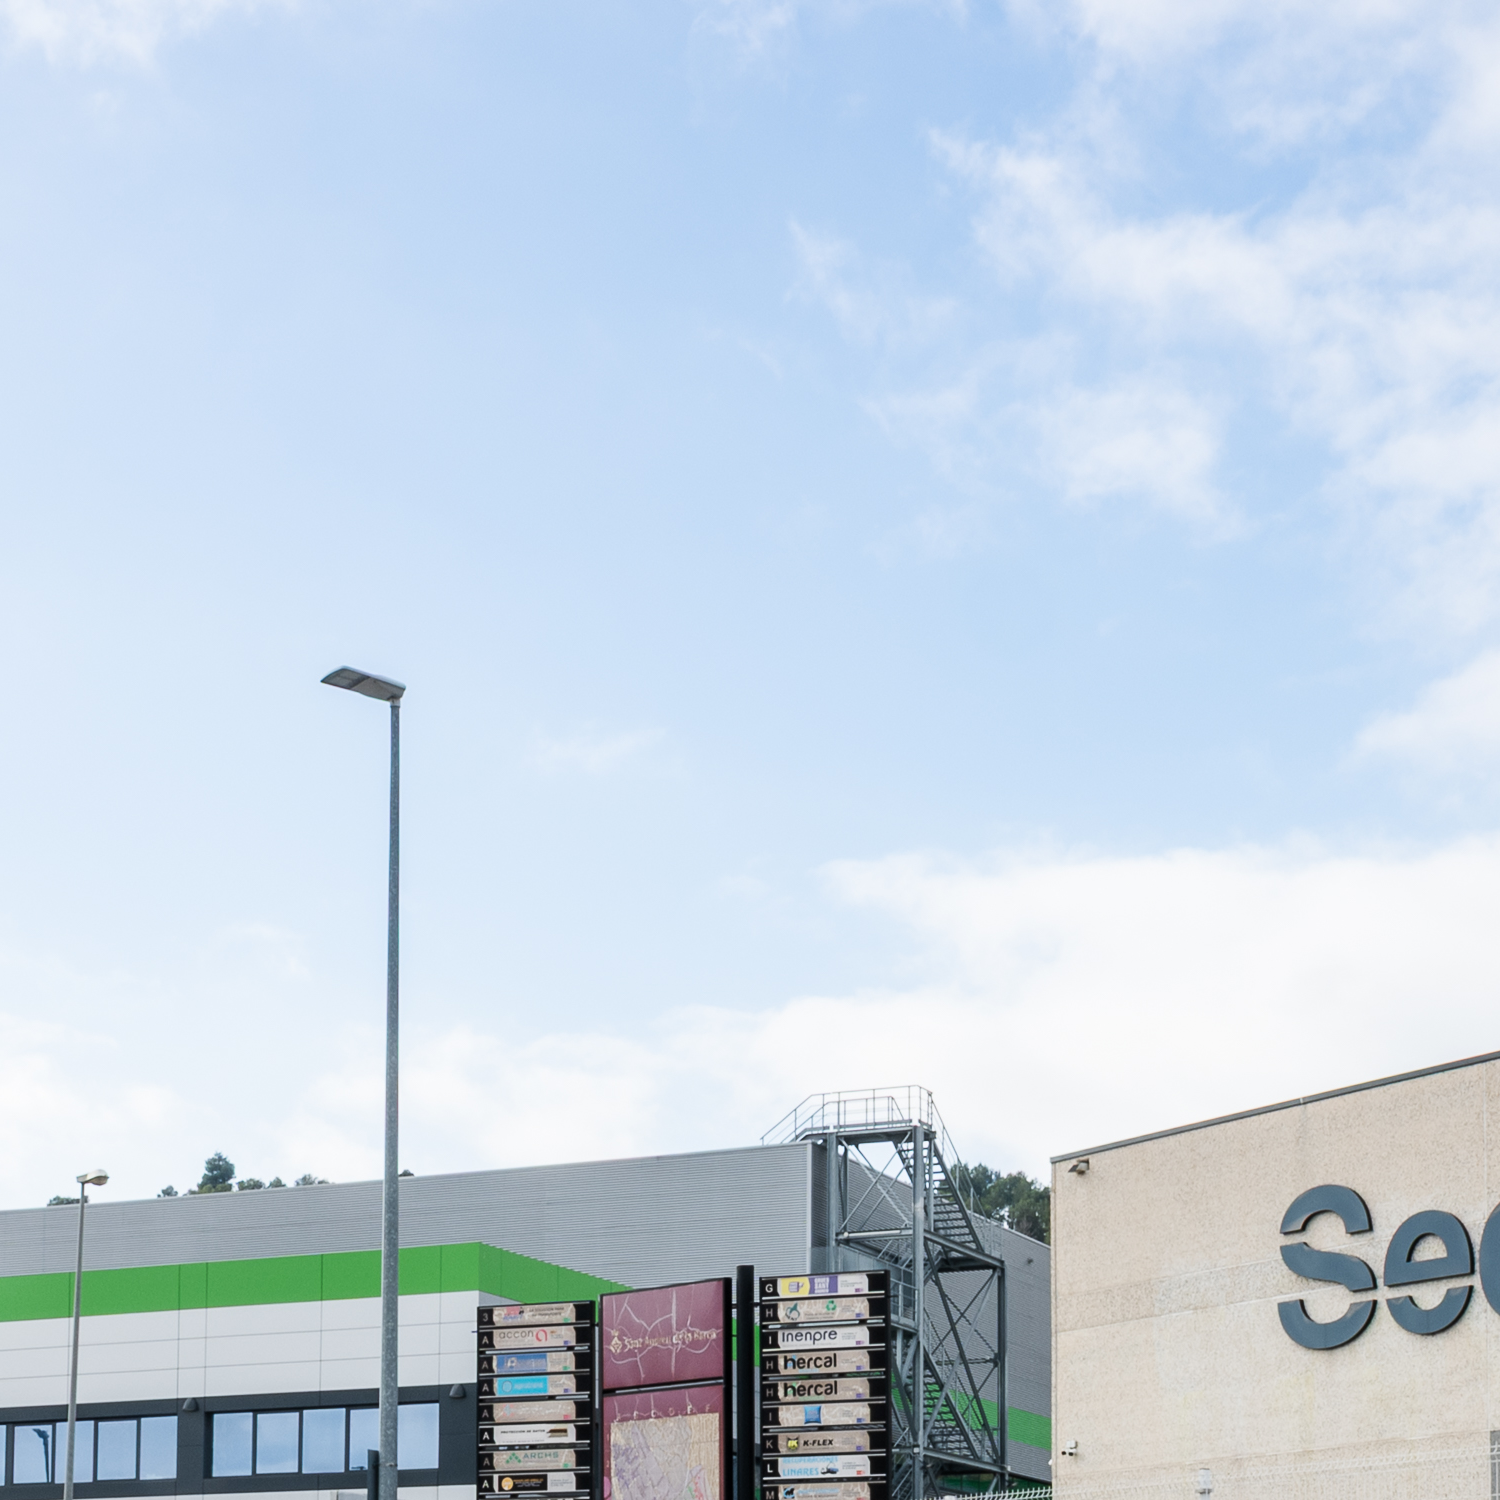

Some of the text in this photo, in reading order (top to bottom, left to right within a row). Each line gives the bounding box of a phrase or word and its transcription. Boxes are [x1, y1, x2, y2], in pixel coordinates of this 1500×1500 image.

[765, 1284, 773, 1293] G
[482, 1313, 488, 1321] 3
[766, 1308, 773, 1317] H
[482, 1336, 489, 1344] A
[482, 1361, 489, 1369] A
[766, 1353, 837, 1370] H hercal
[482, 1383, 489, 1392] A
[766, 1380, 837, 1397] H hercal
[482, 1409, 489, 1418] A
[483, 1431, 490, 1440] A
[766, 1439, 833, 1449] K K-FLEX
[483, 1458, 490, 1466] A
[523, 1451, 559, 1459] ARCHS
[767, 1464, 819, 1476] L LINARES
[482, 1480, 489, 1488] A
[766, 1491, 774, 1499] M
